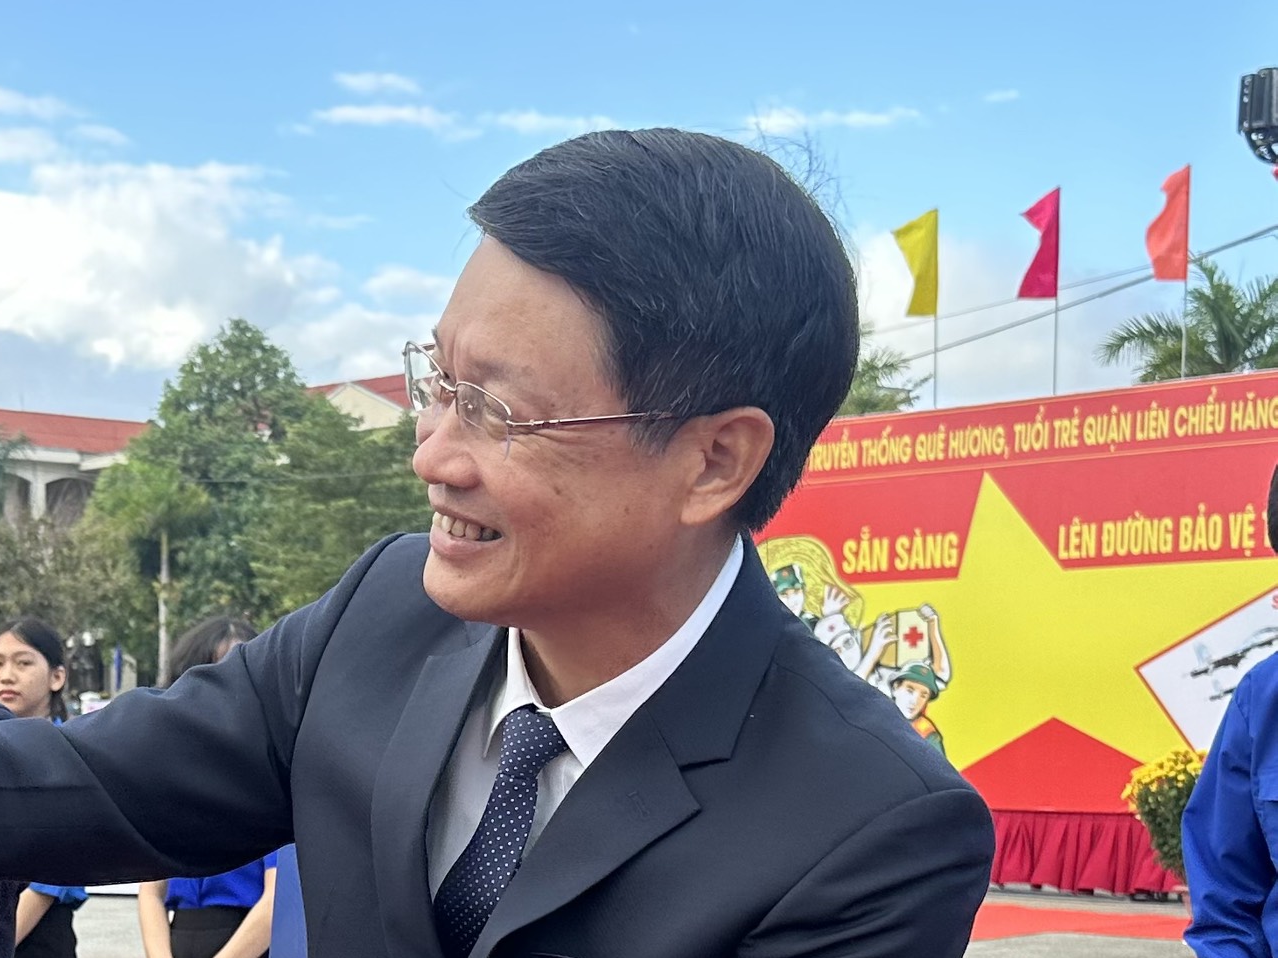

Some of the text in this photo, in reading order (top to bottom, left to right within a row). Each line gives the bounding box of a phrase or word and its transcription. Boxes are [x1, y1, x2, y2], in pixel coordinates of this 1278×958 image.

[861, 425, 912, 467] THỐNG
[914, 424, 945, 463] QUÊ
[948, 424, 1009, 460] HƯƠNG,
[1013, 405, 1049, 452] TUỔI
[1053, 406, 1080, 449] TRẺ
[1083, 405, 1131, 453] QUẬN
[1136, 400, 1170, 441] LIÊN
[1174, 386, 1226, 437] CHIỂU
[842, 525, 889, 574] SẴN
[894, 527, 959, 571] SÀNG
[1058, 516, 1097, 560] LÊN
[1101, 510, 1173, 557] ĐƯỜNG
[1179, 502, 1222, 552] BẢO
[1229, 503, 1256, 557] VỆ
